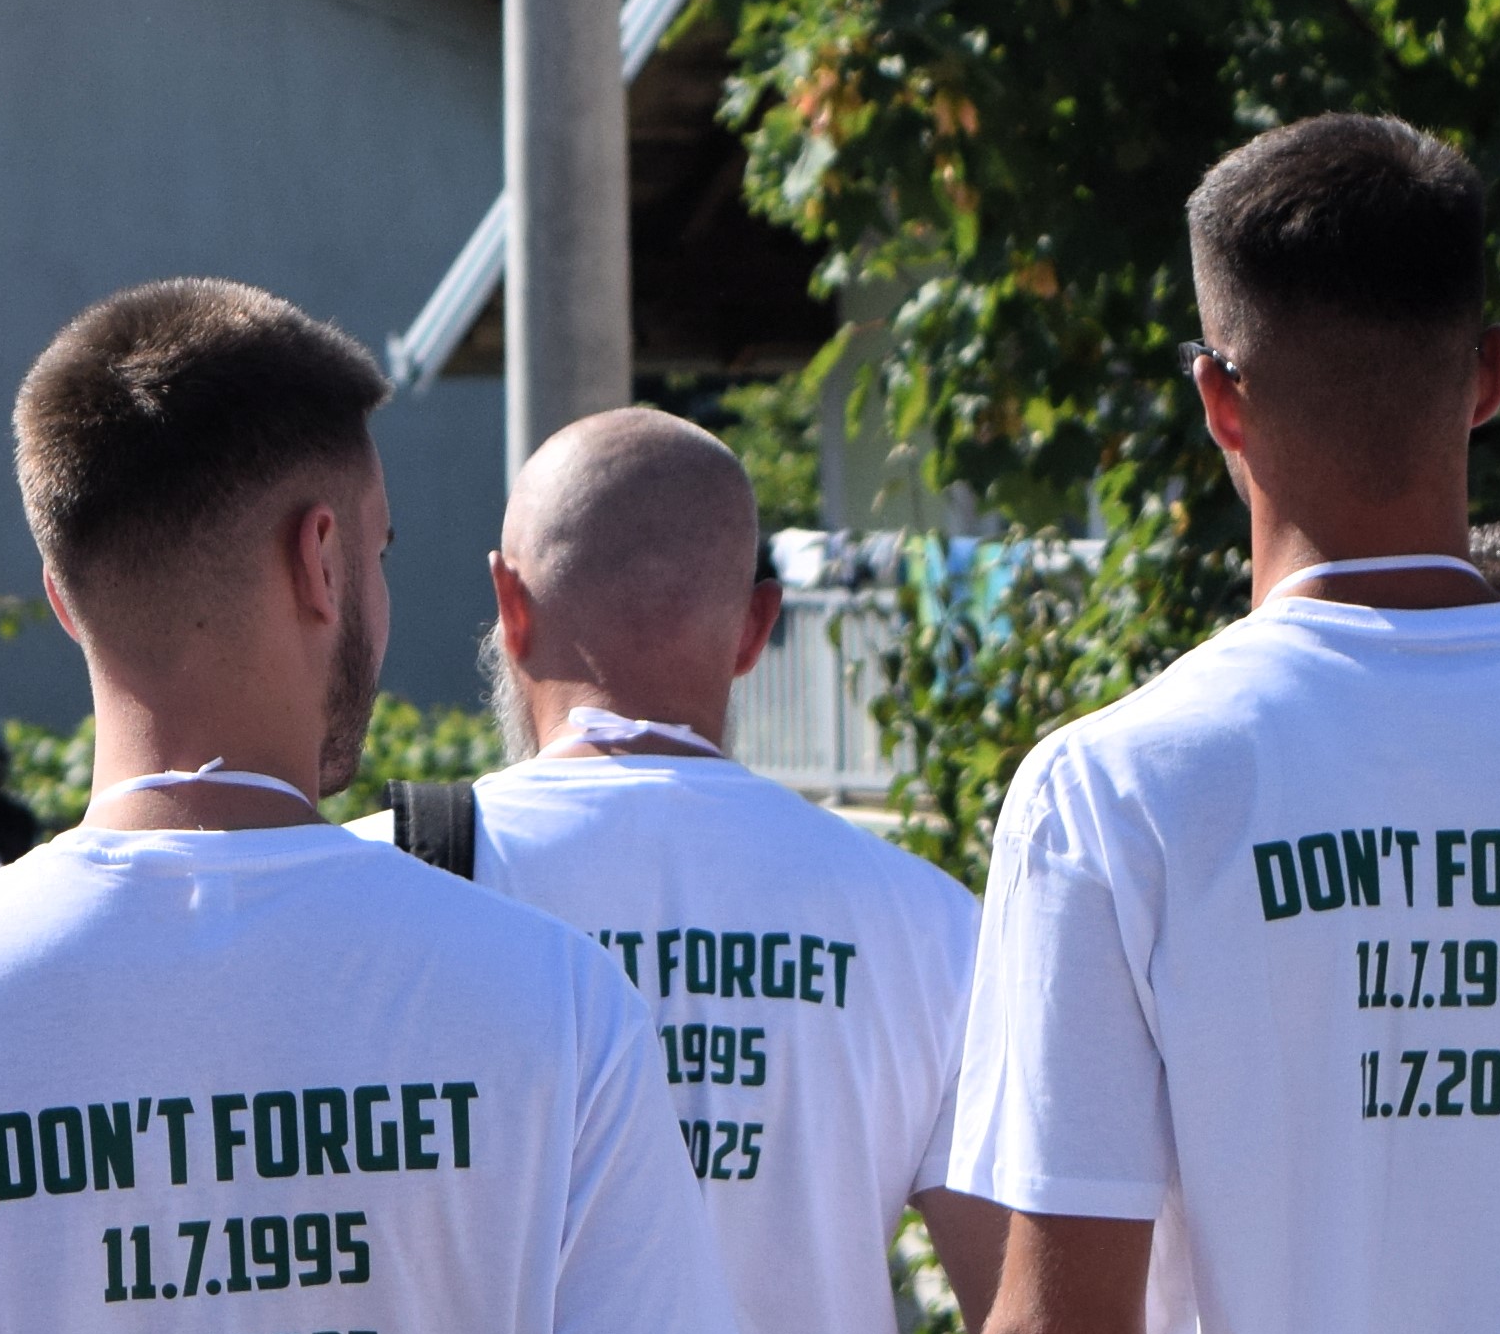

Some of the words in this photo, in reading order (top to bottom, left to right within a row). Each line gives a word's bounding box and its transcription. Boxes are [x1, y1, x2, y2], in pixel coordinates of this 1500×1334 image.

[1252, 826, 1421, 921] DON'T
[657, 927, 857, 1009] FORGET
[211, 1081, 479, 1181] FORGET
[101, 1210, 370, 1303] 11.7.1995
